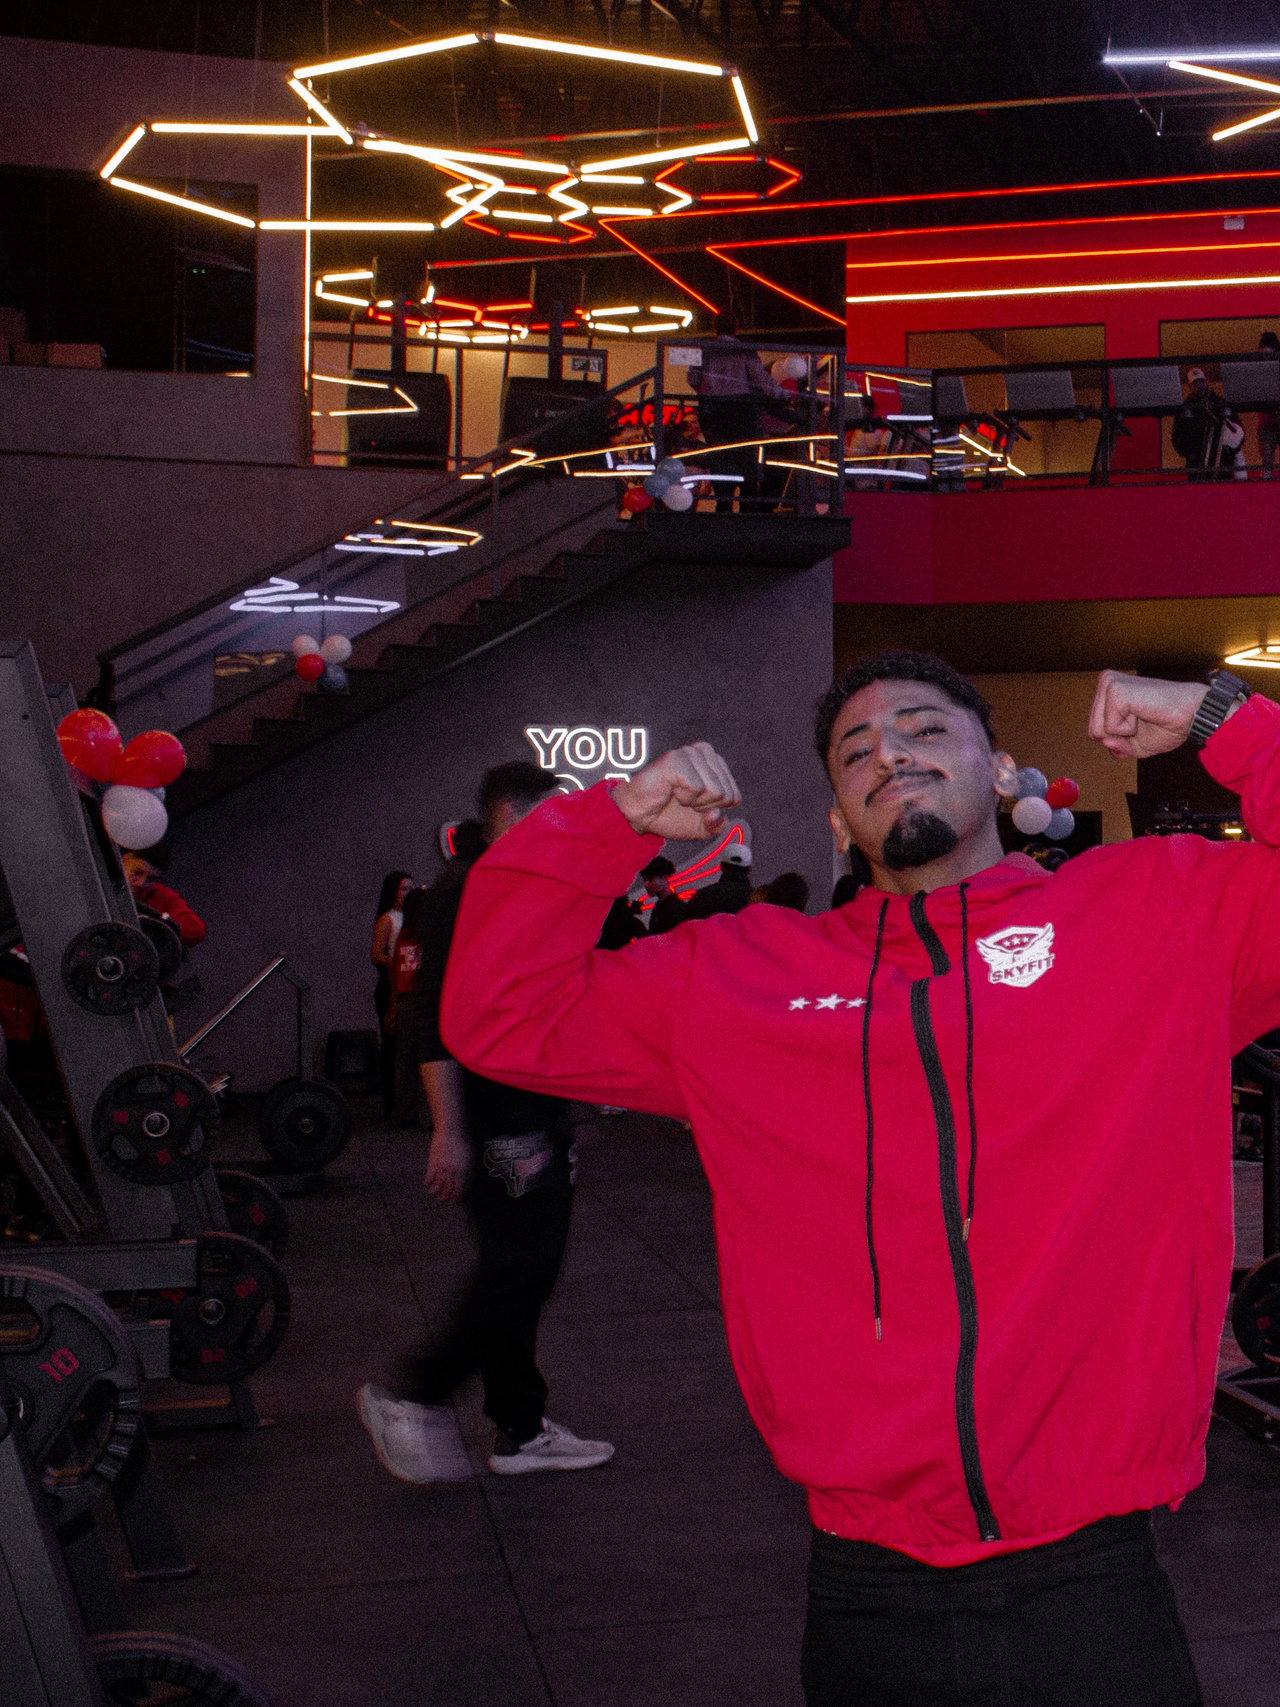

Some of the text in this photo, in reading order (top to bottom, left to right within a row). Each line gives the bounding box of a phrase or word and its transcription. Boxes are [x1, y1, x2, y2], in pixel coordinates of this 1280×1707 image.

[526, 727, 646, 769] YOU
[991, 956, 1054, 982] SKYFIT
[39, 1347, 80, 1382] 10
